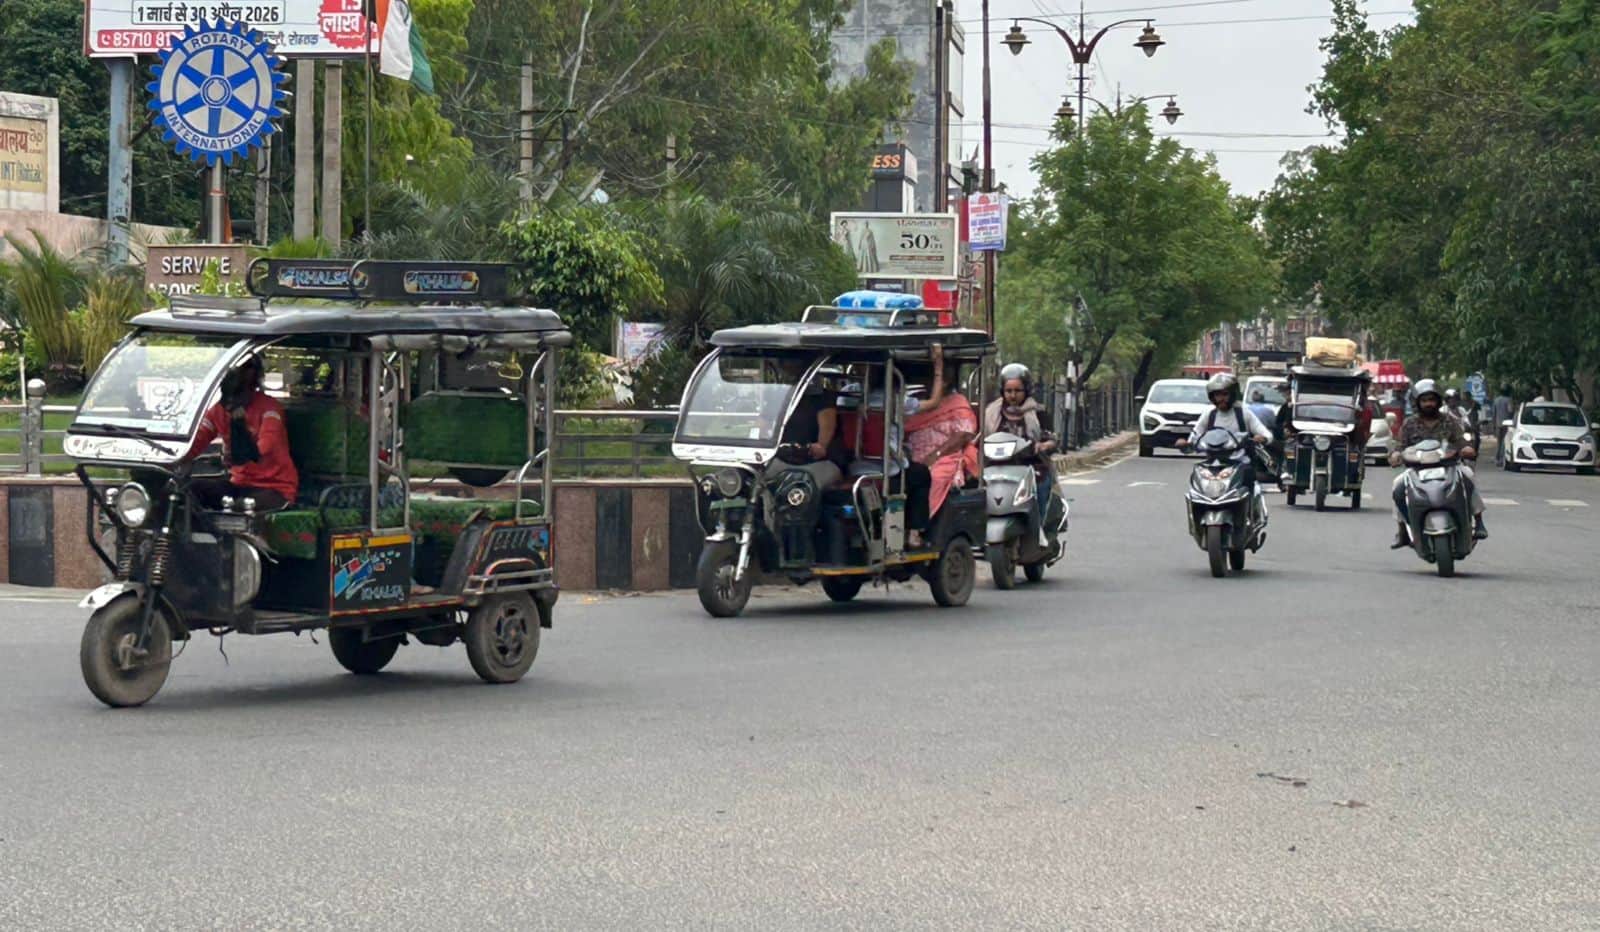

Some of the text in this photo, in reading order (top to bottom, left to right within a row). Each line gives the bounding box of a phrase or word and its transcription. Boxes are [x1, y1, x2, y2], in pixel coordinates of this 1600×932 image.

[138, 7, 143, 21] 1
[147, 2, 172, 21] मार्च
[175, 2, 187, 21] से
[190, 7, 206, 21] 30
[245, 7, 279, 21] 2026
[321, 12, 362, 33] लाख
[113, 32, 152, 48] 85710
[192, 33, 249, 49] ROTARY
[168, 113, 264, 149] INTERNATIONAL
